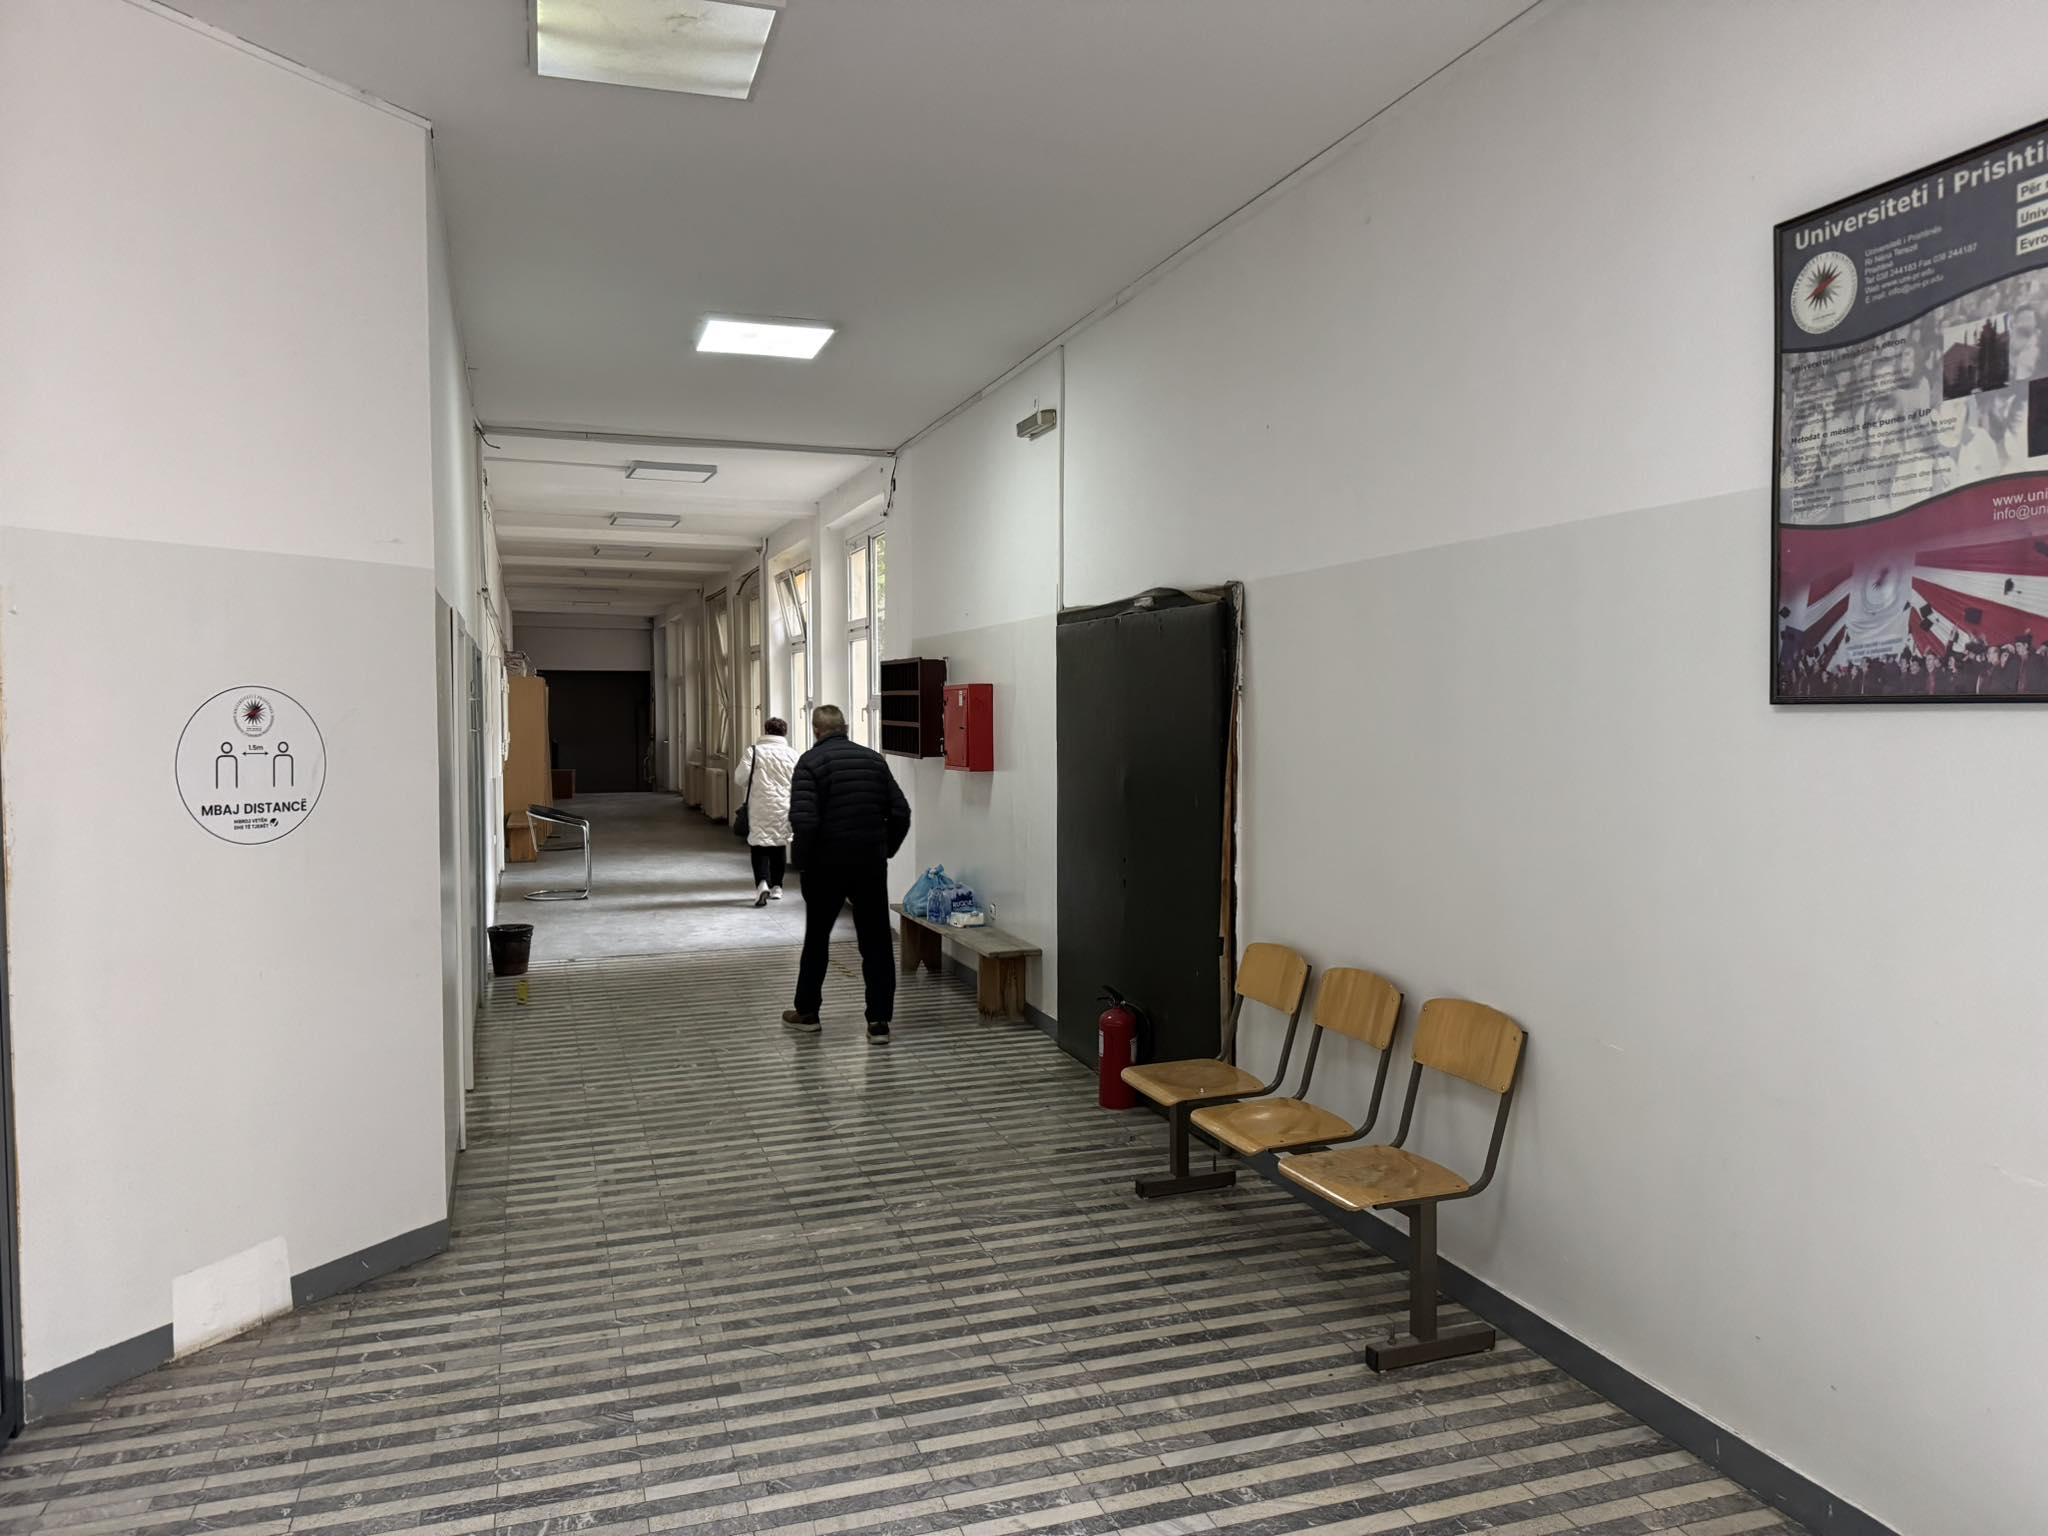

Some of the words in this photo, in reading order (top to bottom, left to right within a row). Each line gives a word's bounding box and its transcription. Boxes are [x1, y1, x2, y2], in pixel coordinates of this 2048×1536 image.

[1795, 184, 1928, 250] Universiteti
[1938, 178, 1944, 200] i
[1954, 140, 2048, 195] Prishti
[2020, 183, 2041, 198] Për
[201, 803, 240, 816] MBAJ
[244, 798, 307, 815] DISTANCË
